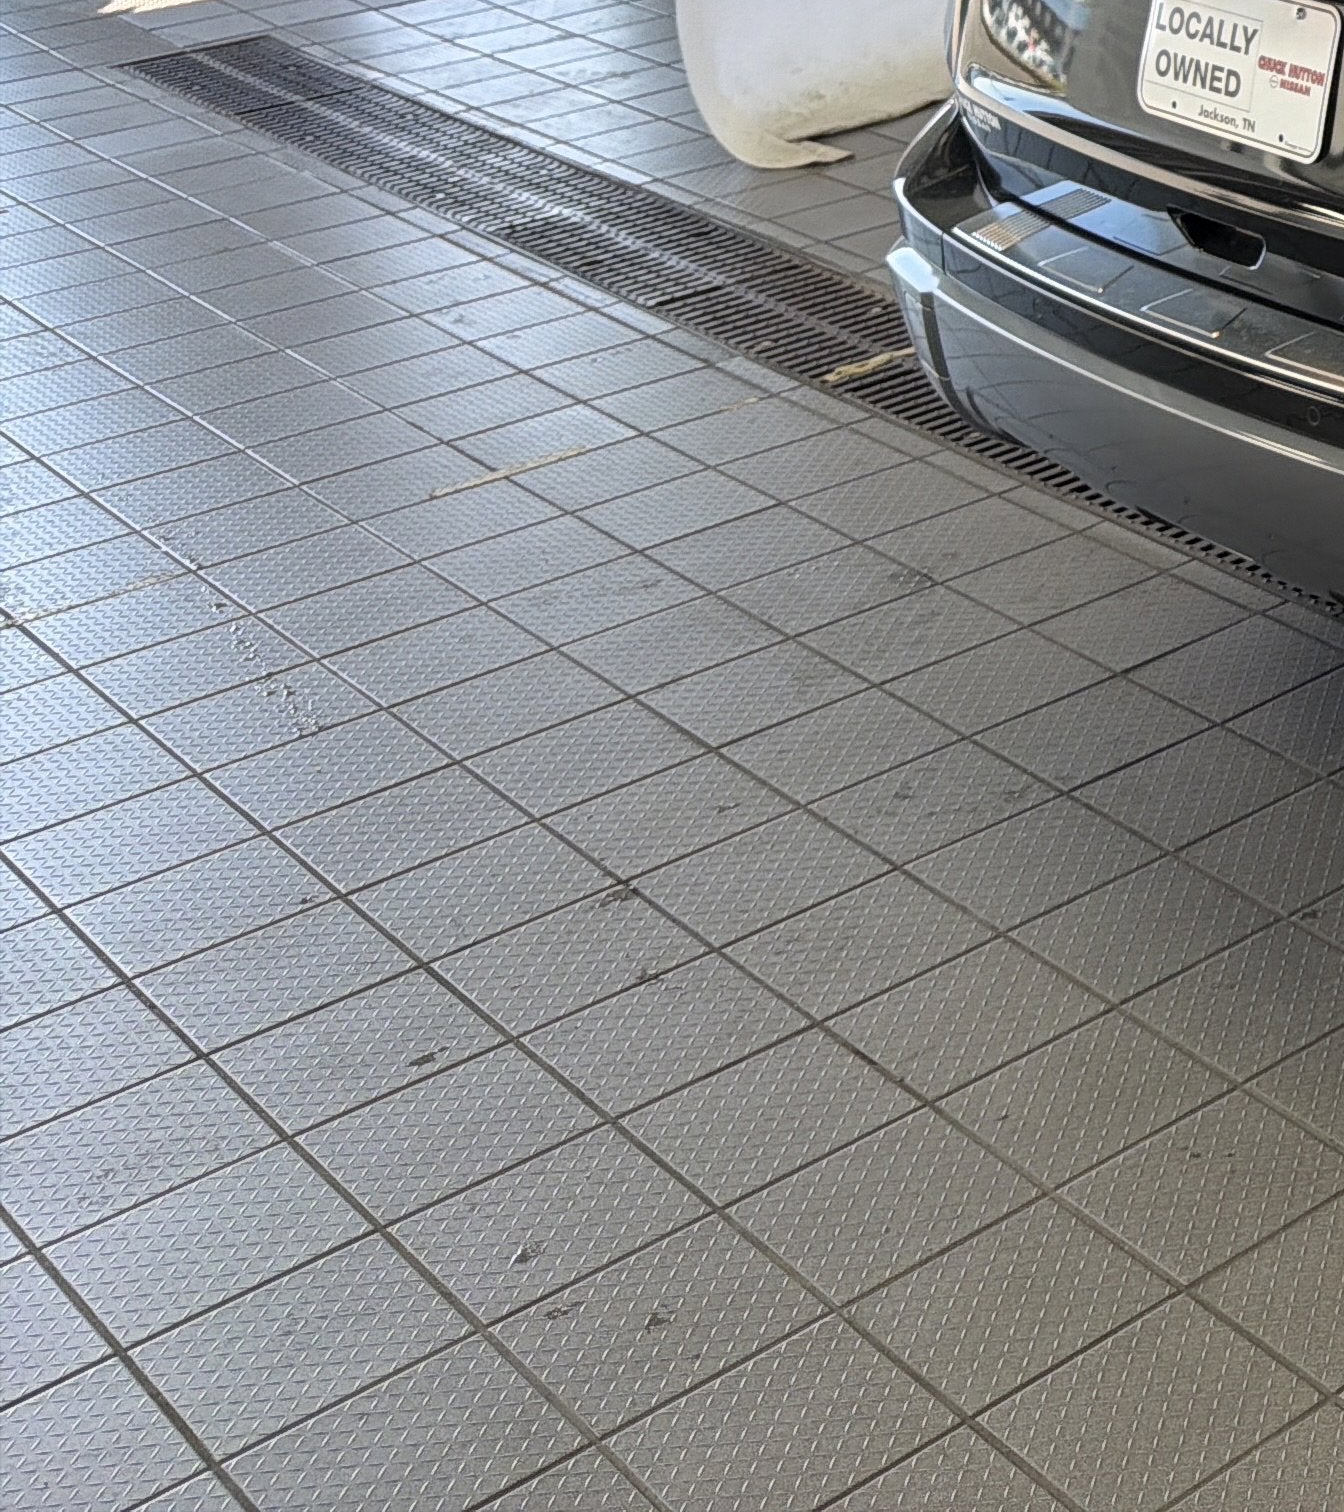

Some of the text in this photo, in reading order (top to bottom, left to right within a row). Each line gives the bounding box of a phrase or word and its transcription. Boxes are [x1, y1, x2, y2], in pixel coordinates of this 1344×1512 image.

[1155, 2, 1259, 56] LOCALLY
[1155, 49, 1241, 98] OWNED
[1257, 54, 1326, 87] CHUCK HUTTON
[1279, 78, 1312, 96] NISSAN
[1198, 104, 1256, 133] Jackson, TN
